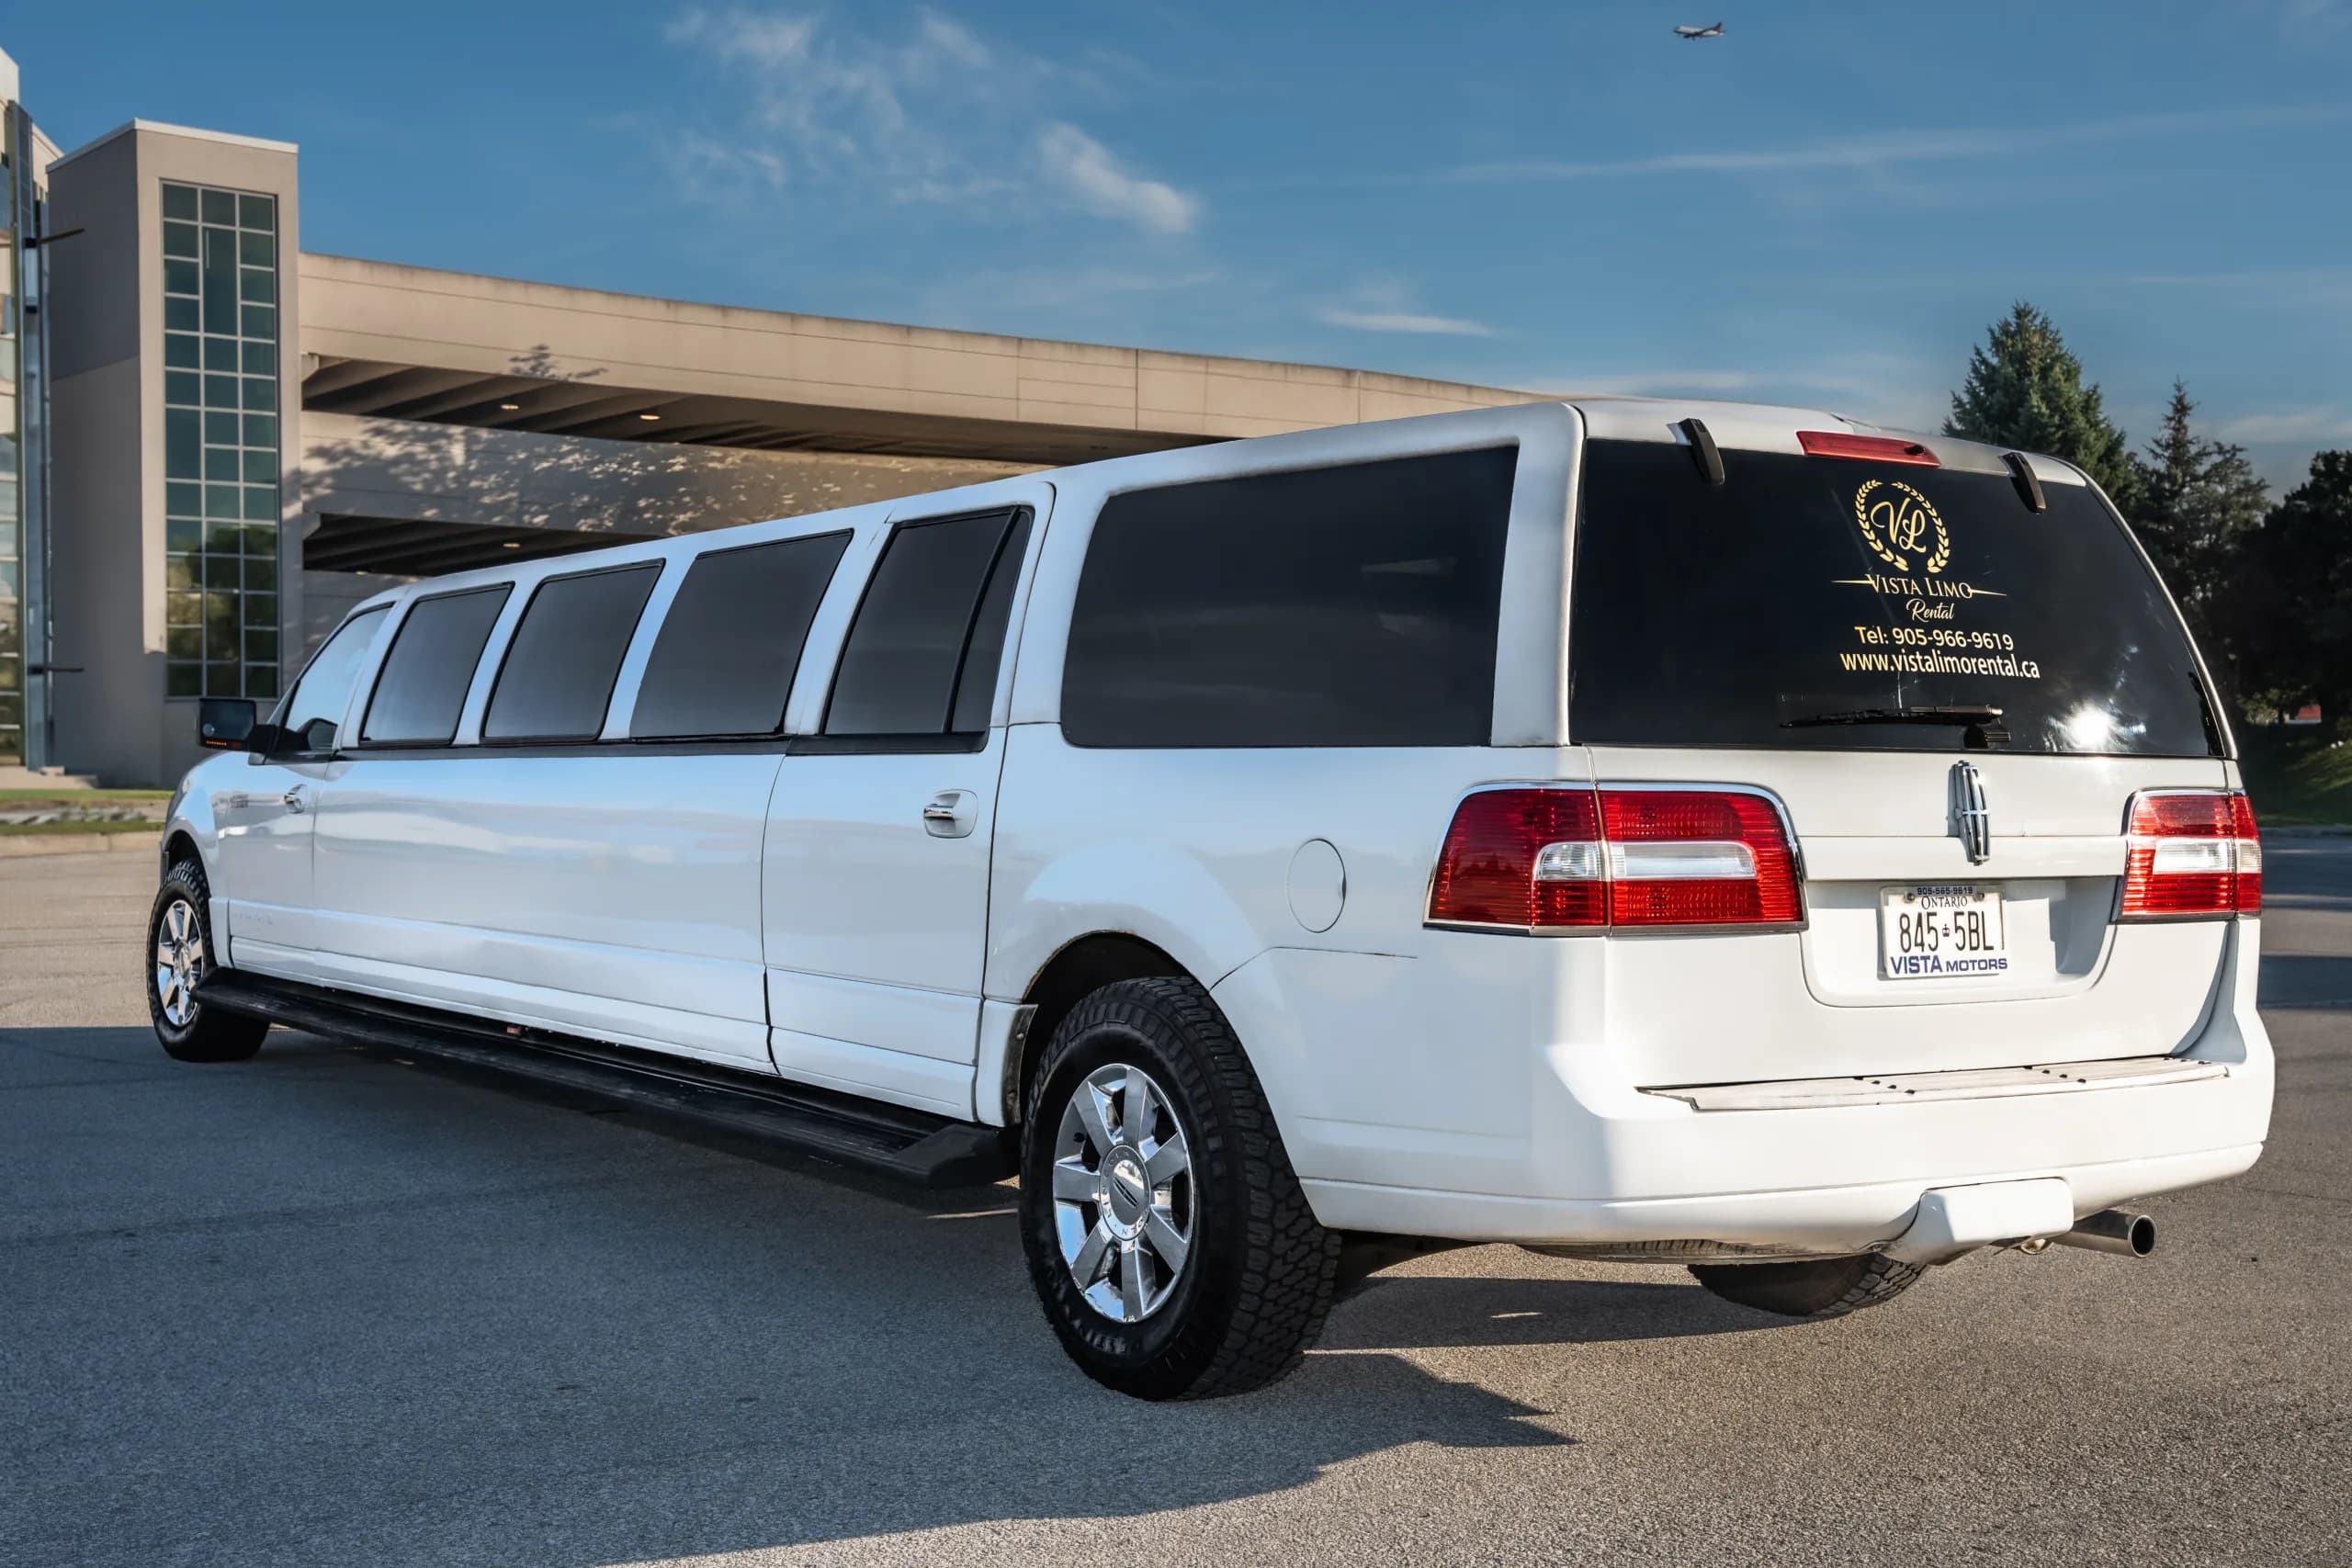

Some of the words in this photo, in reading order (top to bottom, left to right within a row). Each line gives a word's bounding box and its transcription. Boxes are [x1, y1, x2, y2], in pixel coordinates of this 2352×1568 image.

[1864, 573, 1923, 595] VISTA
[1924, 577, 1973, 599] LIMO
[1905, 598, 1955, 623] Rental
[1854, 626, 1889, 645] Tel:
[1892, 627, 2015, 651] 905-966-9619
[1839, 649, 2041, 679] www.vistalimorental.ca
[1921, 896, 1968, 910] ONTARIO
[1899, 911, 1939, 953] 845
[1953, 911, 1995, 952] 5BL
[1890, 955, 1943, 975] VISTA
[1945, 958, 2008, 973] MOTORS
